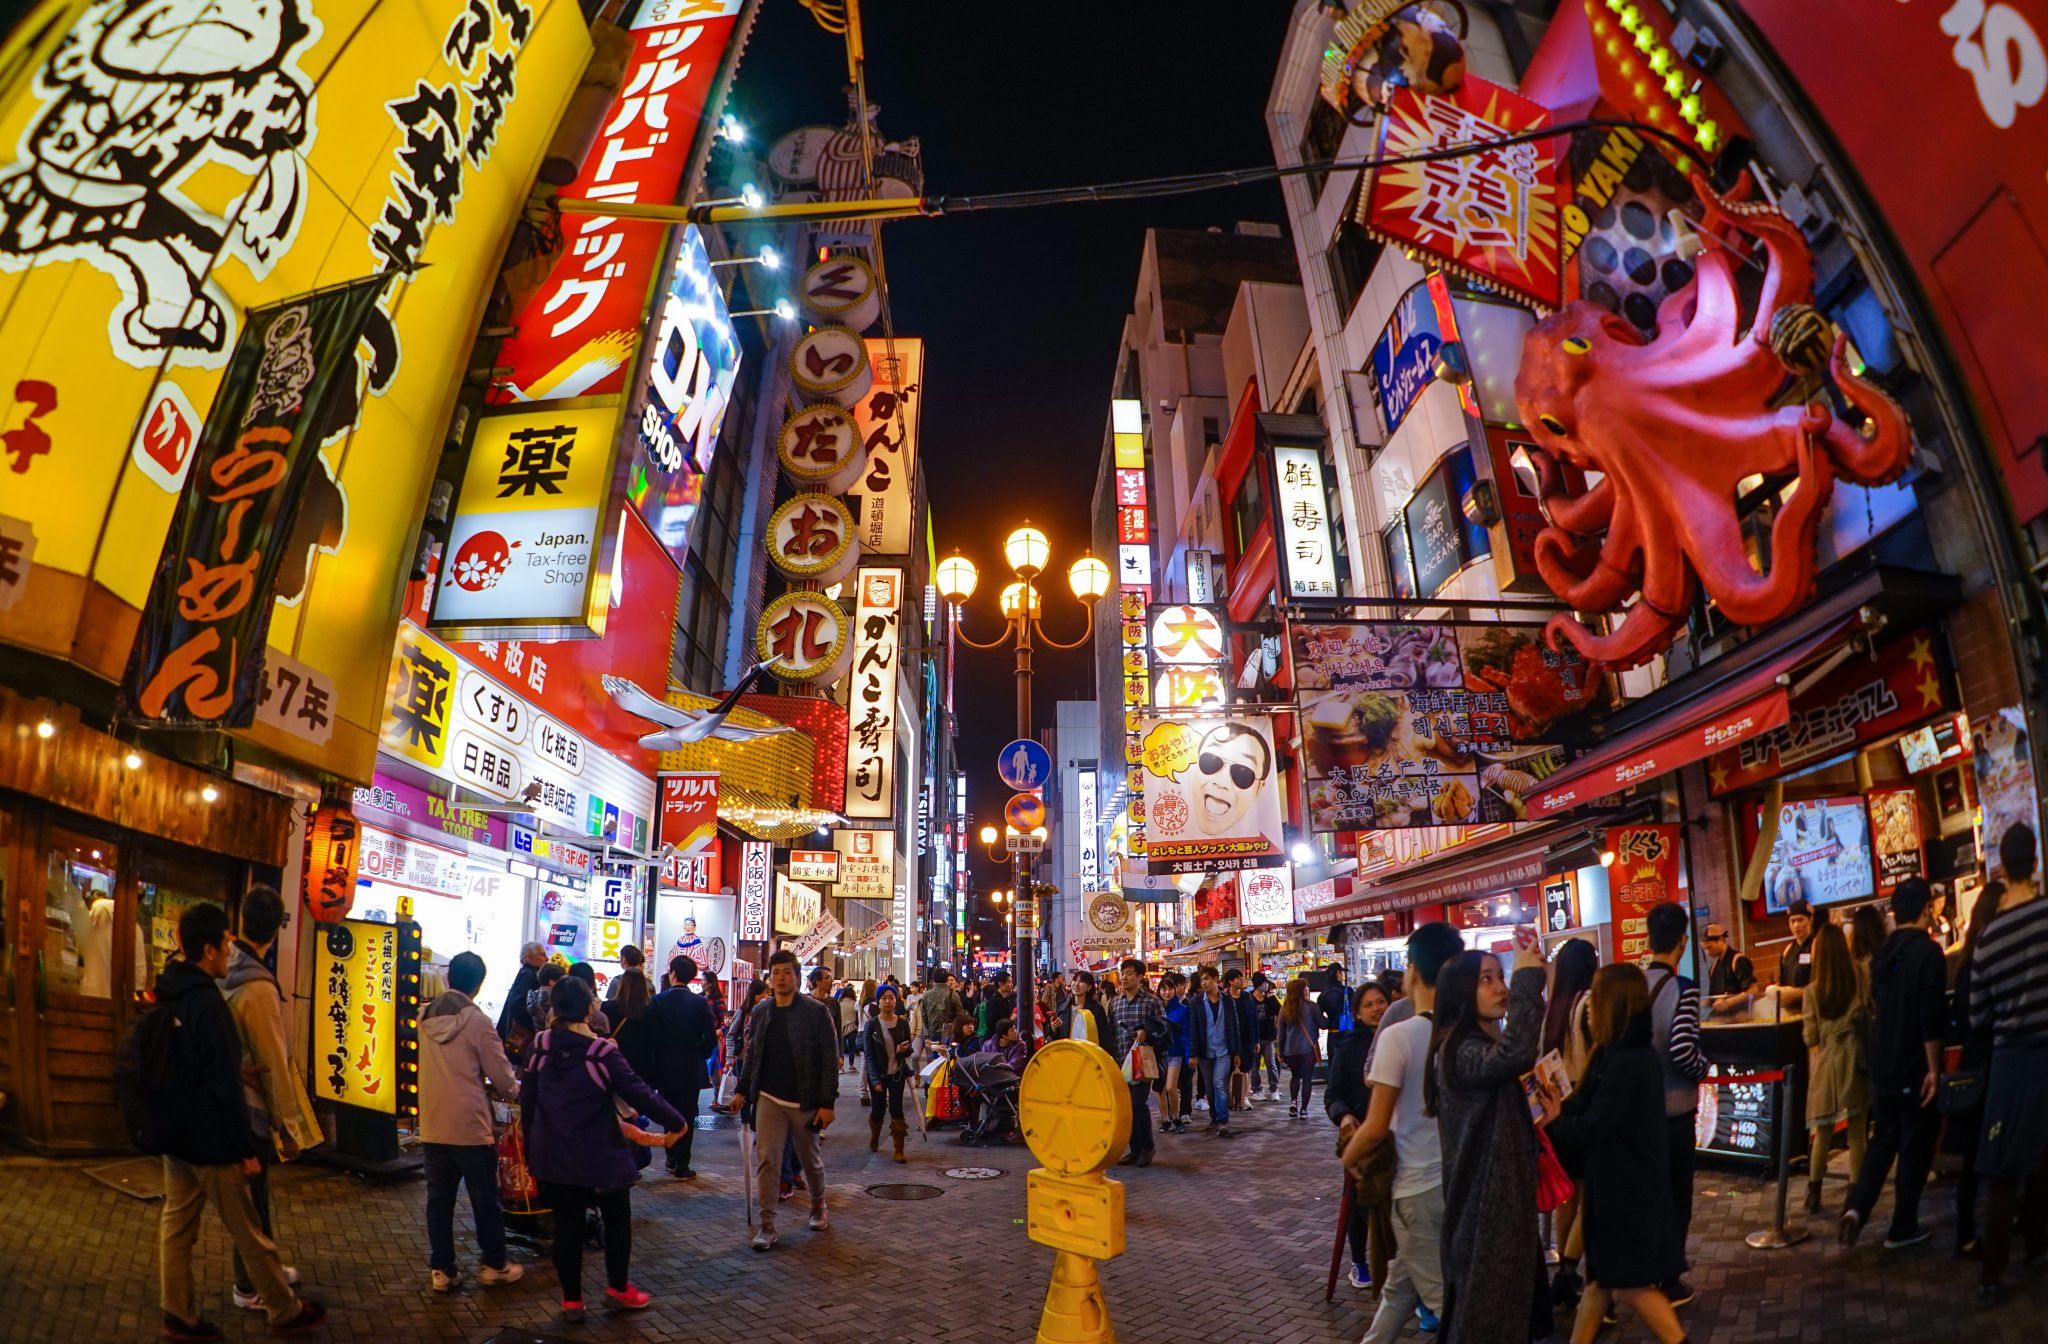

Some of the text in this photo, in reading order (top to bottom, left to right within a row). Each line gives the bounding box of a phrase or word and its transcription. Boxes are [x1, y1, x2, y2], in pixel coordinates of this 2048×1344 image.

[550, 25, 704, 337] ツルハドラッグ
[1577, 126, 1644, 208] YAKI
[651, 292, 726, 474] OK
[642, 404, 682, 474] SHOP
[865, 384, 918, 492] がんこ
[496, 425, 578, 498] 薬
[535, 532, 589, 549] Japan.
[869, 497, 885, 547] 道頓堀店
[1426, 521, 1445, 546] BAR
[140, 426, 293, 720] らーめん
[526, 552, 587, 567] Tax-free
[544, 570, 584, 587] Shop
[1307, 637, 1382, 659] 欢迎光临
[1315, 660, 1386, 678] 어서오세요
[391, 642, 451, 756] 薬
[1559, 669, 1575, 689] 게
[473, 685, 519, 733] くすり
[464, 742, 512, 790] 日用品
[541, 724, 578, 768] 化粧品
[1147, 733, 1191, 762] おみやげ
[667, 780, 717, 797] ツルハ
[1329, 758, 1438, 785] 大阪名产物
[426, 796, 488, 830] TAX FREE
[665, 801, 707, 813] ドラッグ
[918, 790, 928, 856] TSUTAYA
[1082, 796, 1094, 839] 本場の味
[442, 821, 474, 840] STORE
[1008, 838, 1042, 849] 自動車
[367, 850, 406, 880] OFF
[792, 867, 834, 877] 個室・和食
[746, 848, 765, 935] 大阪紀念品
[842, 884, 885, 894] 寿司・和食
[893, 884, 905, 942] FOREVER
[365, 938, 378, 998] ニンニク
[355, 1004, 381, 1095] ラーメン
